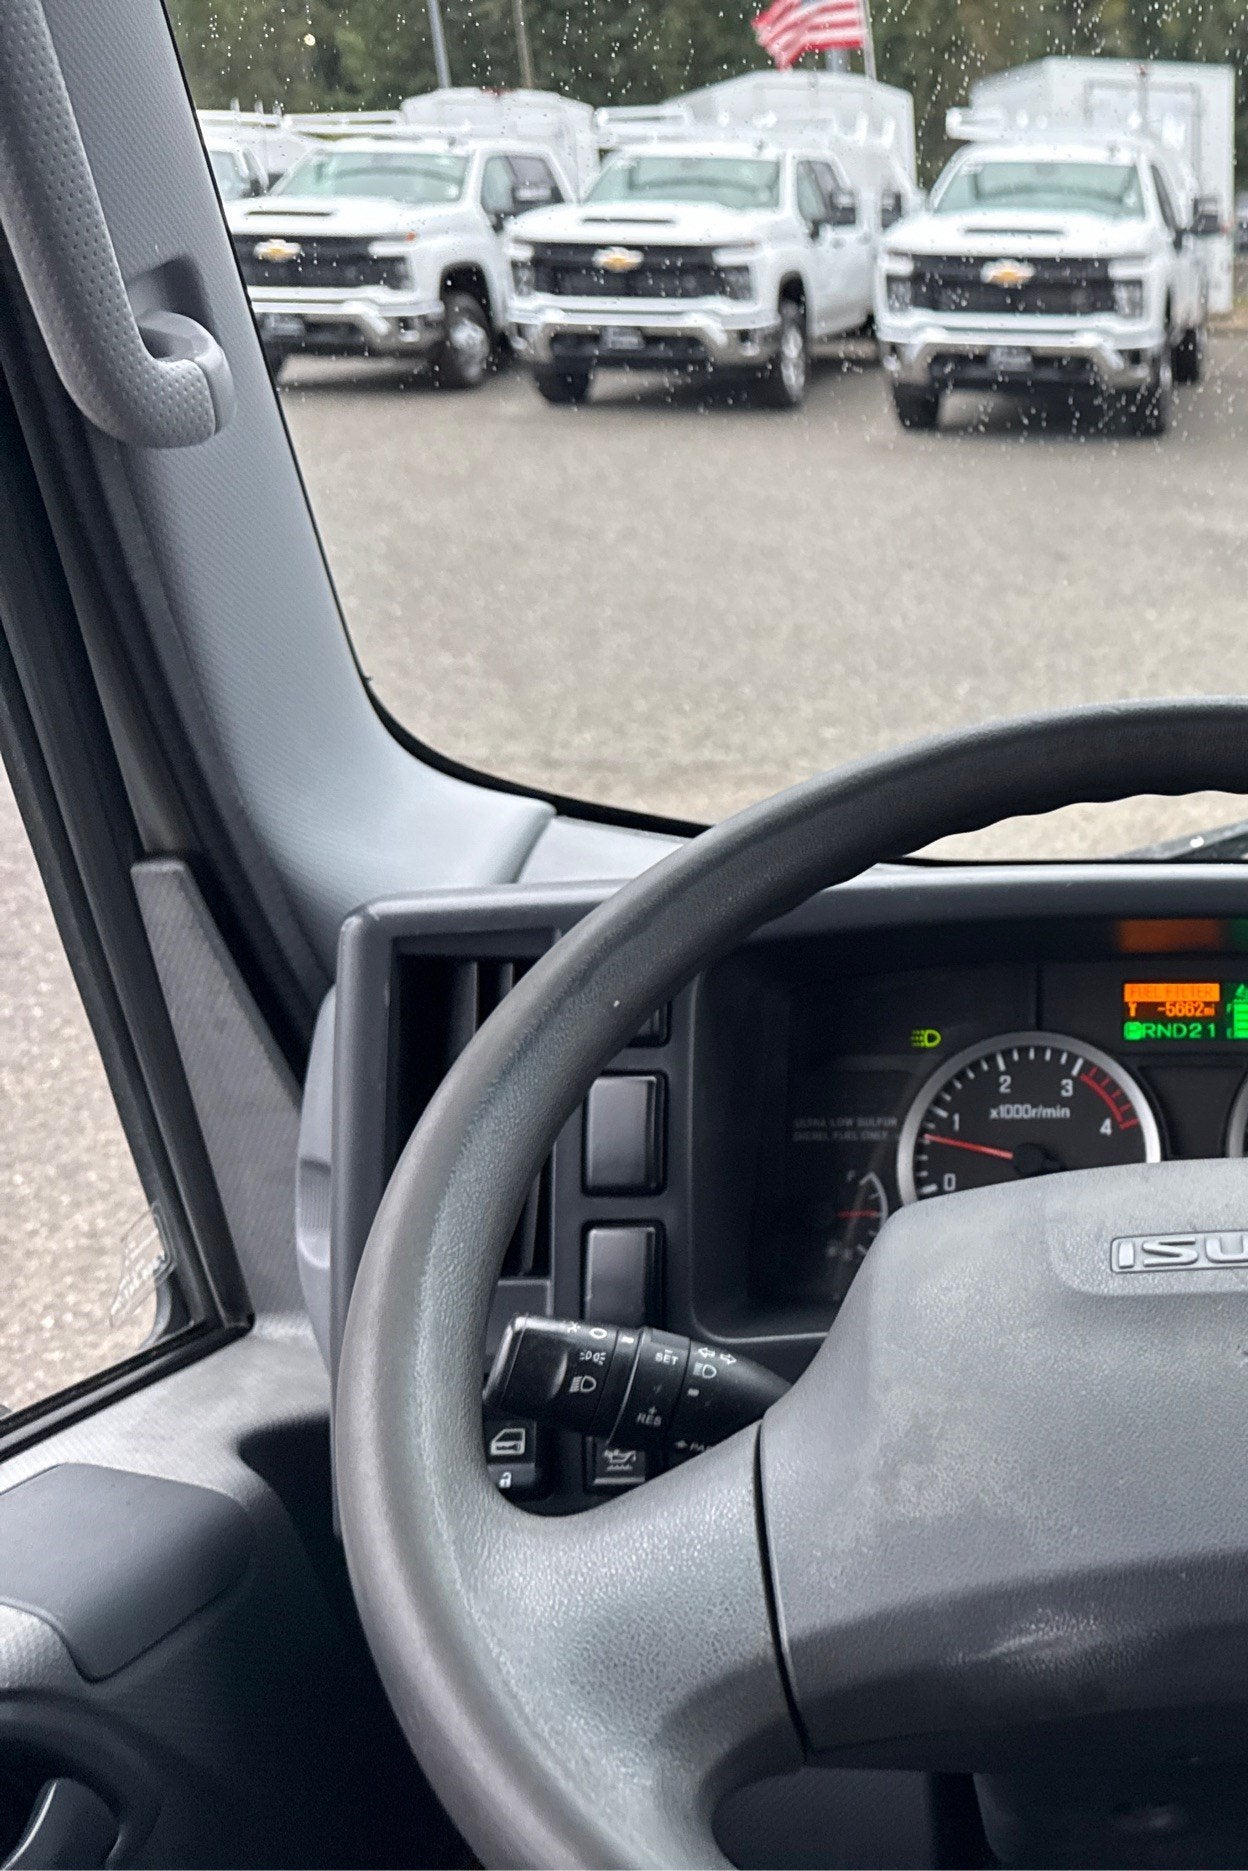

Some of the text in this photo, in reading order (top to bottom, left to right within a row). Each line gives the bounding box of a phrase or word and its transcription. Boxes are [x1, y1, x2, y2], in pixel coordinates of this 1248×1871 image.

[999, 1075, 1012, 1094] 2
[1061, 1079, 1073, 1097] 3
[989, 1104, 1070, 1120] x1000r/min
[952, 1113, 960, 1132] 1
[1100, 1118, 1112, 1136] 4
[943, 1173, 956, 1191] 0
[655, 1352, 679, 1367] SET
[636, 1412, 663, 1427] RES
